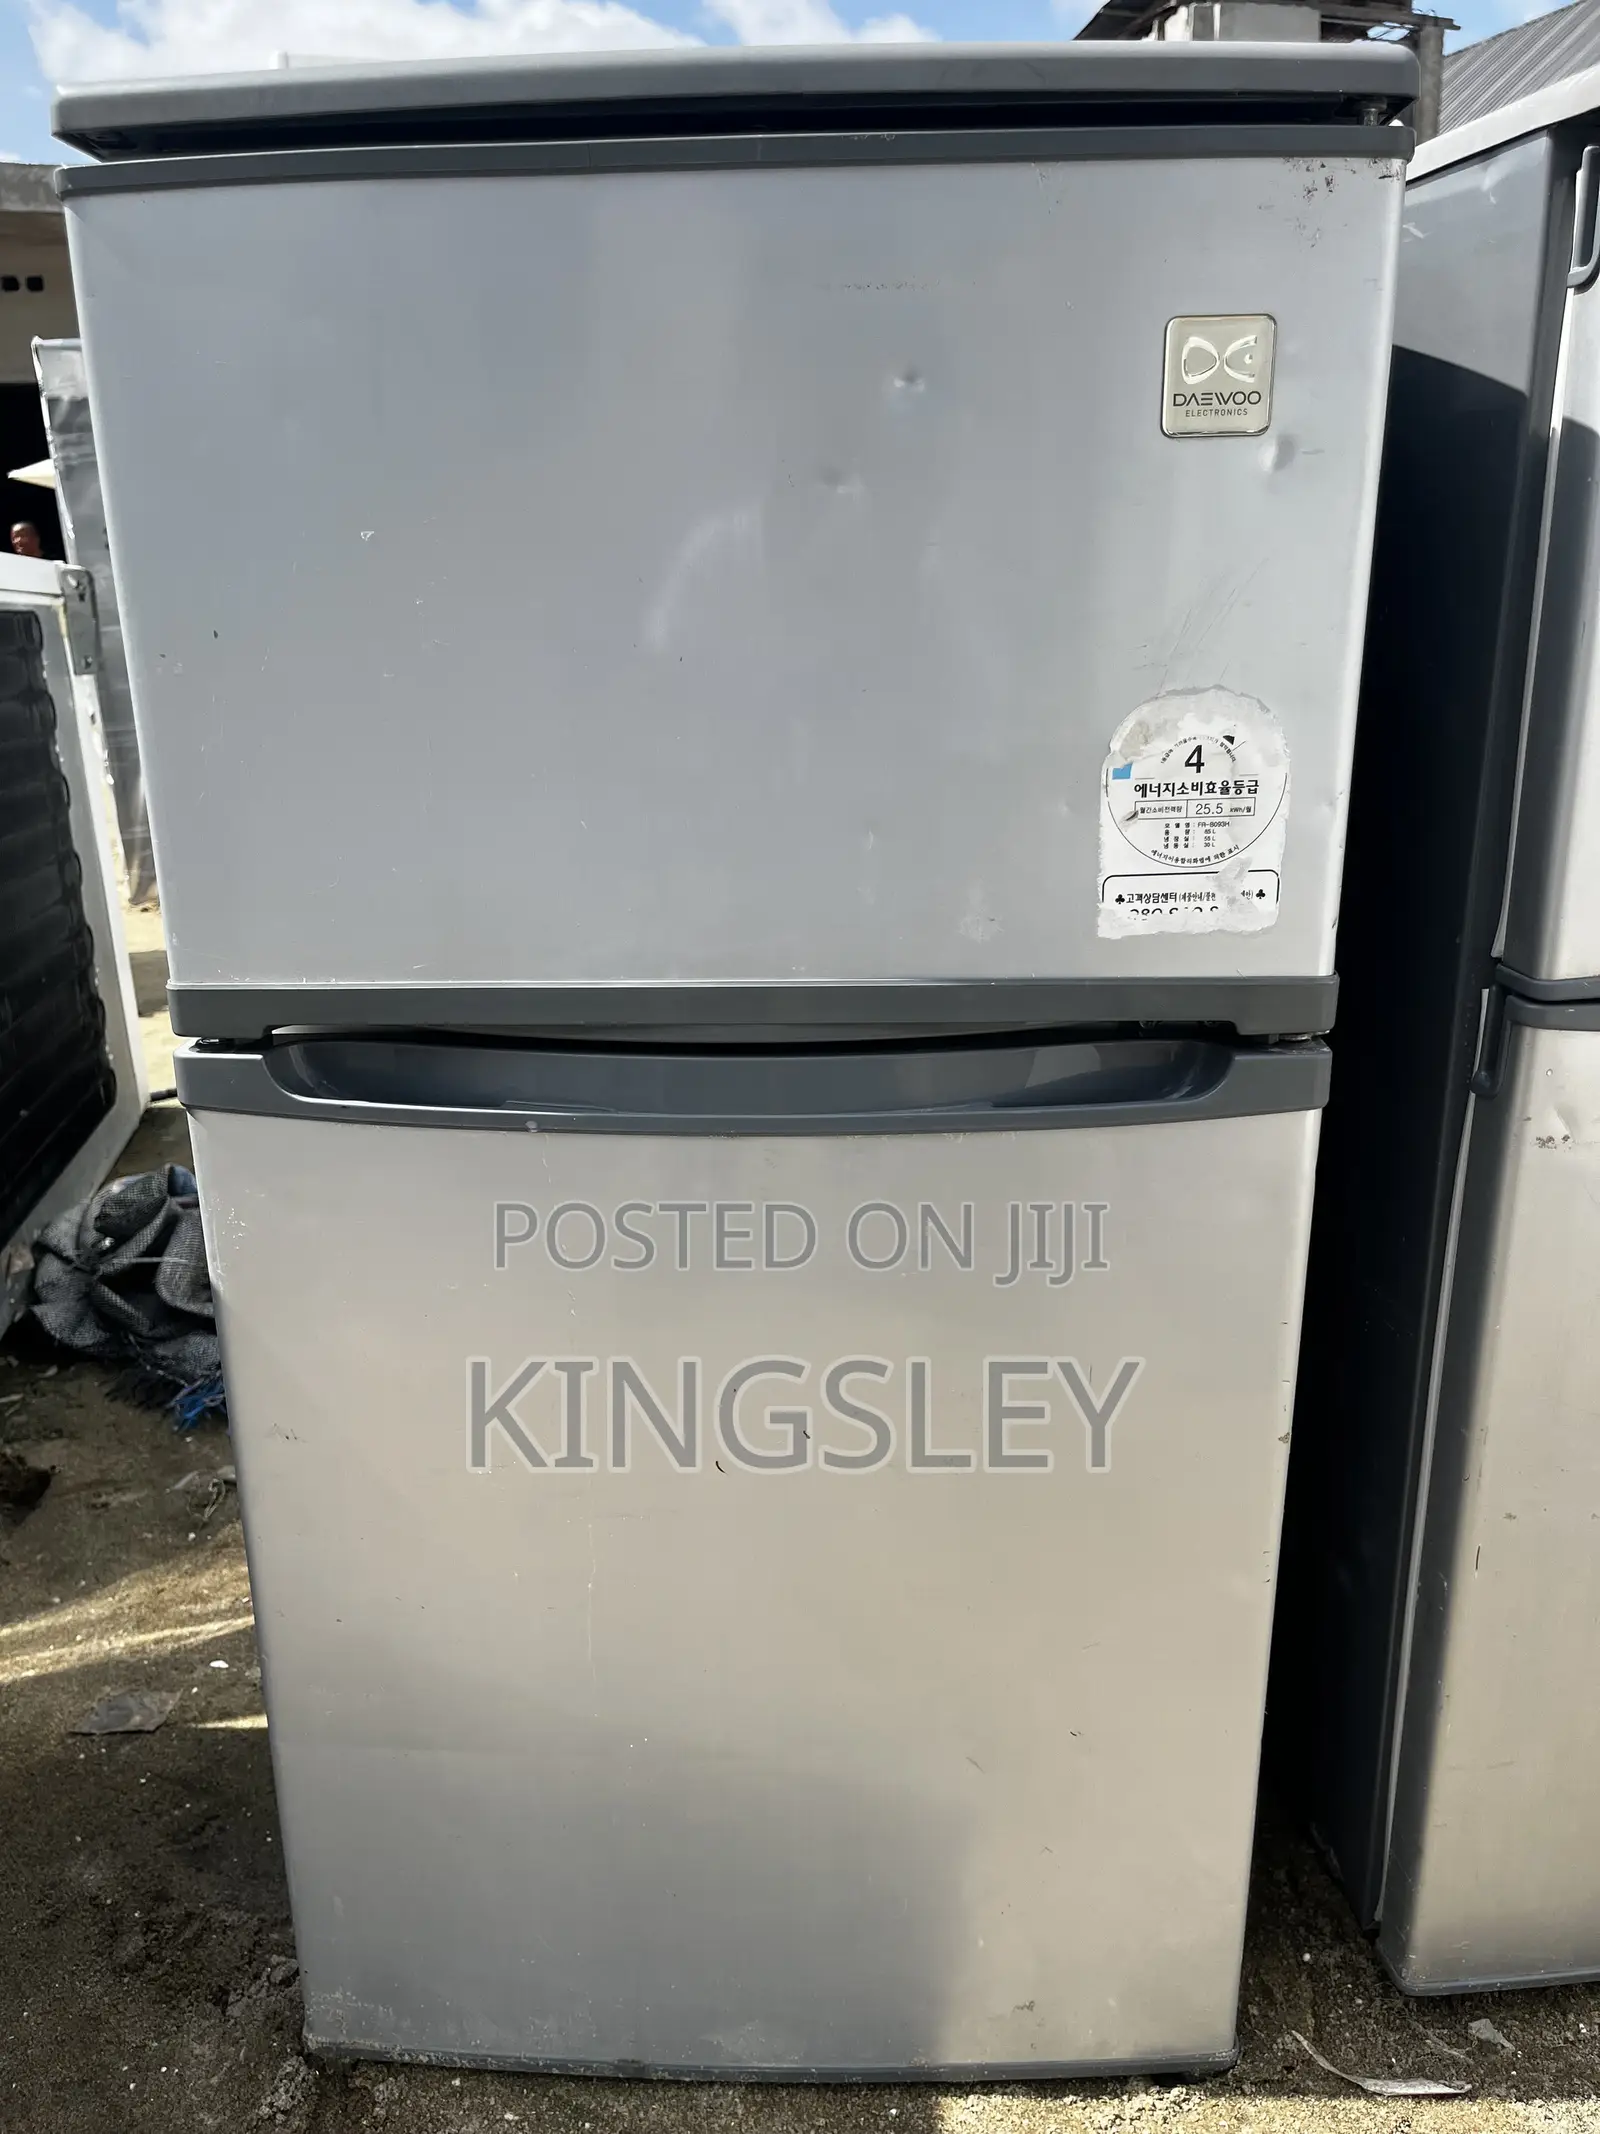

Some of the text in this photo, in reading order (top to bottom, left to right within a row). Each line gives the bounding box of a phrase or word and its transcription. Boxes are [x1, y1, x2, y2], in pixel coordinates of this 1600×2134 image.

[1173, 391, 1262, 407] DAEWOO
[1185, 408, 1248, 418] ELECTRONICS
[1185, 744, 1205, 774] 4
[1133, 779, 1260, 798] 에너지소비효율등급
[1195, 802, 1224, 815] 25.5
[1126, 892, 1178, 904] 고객상담센터
